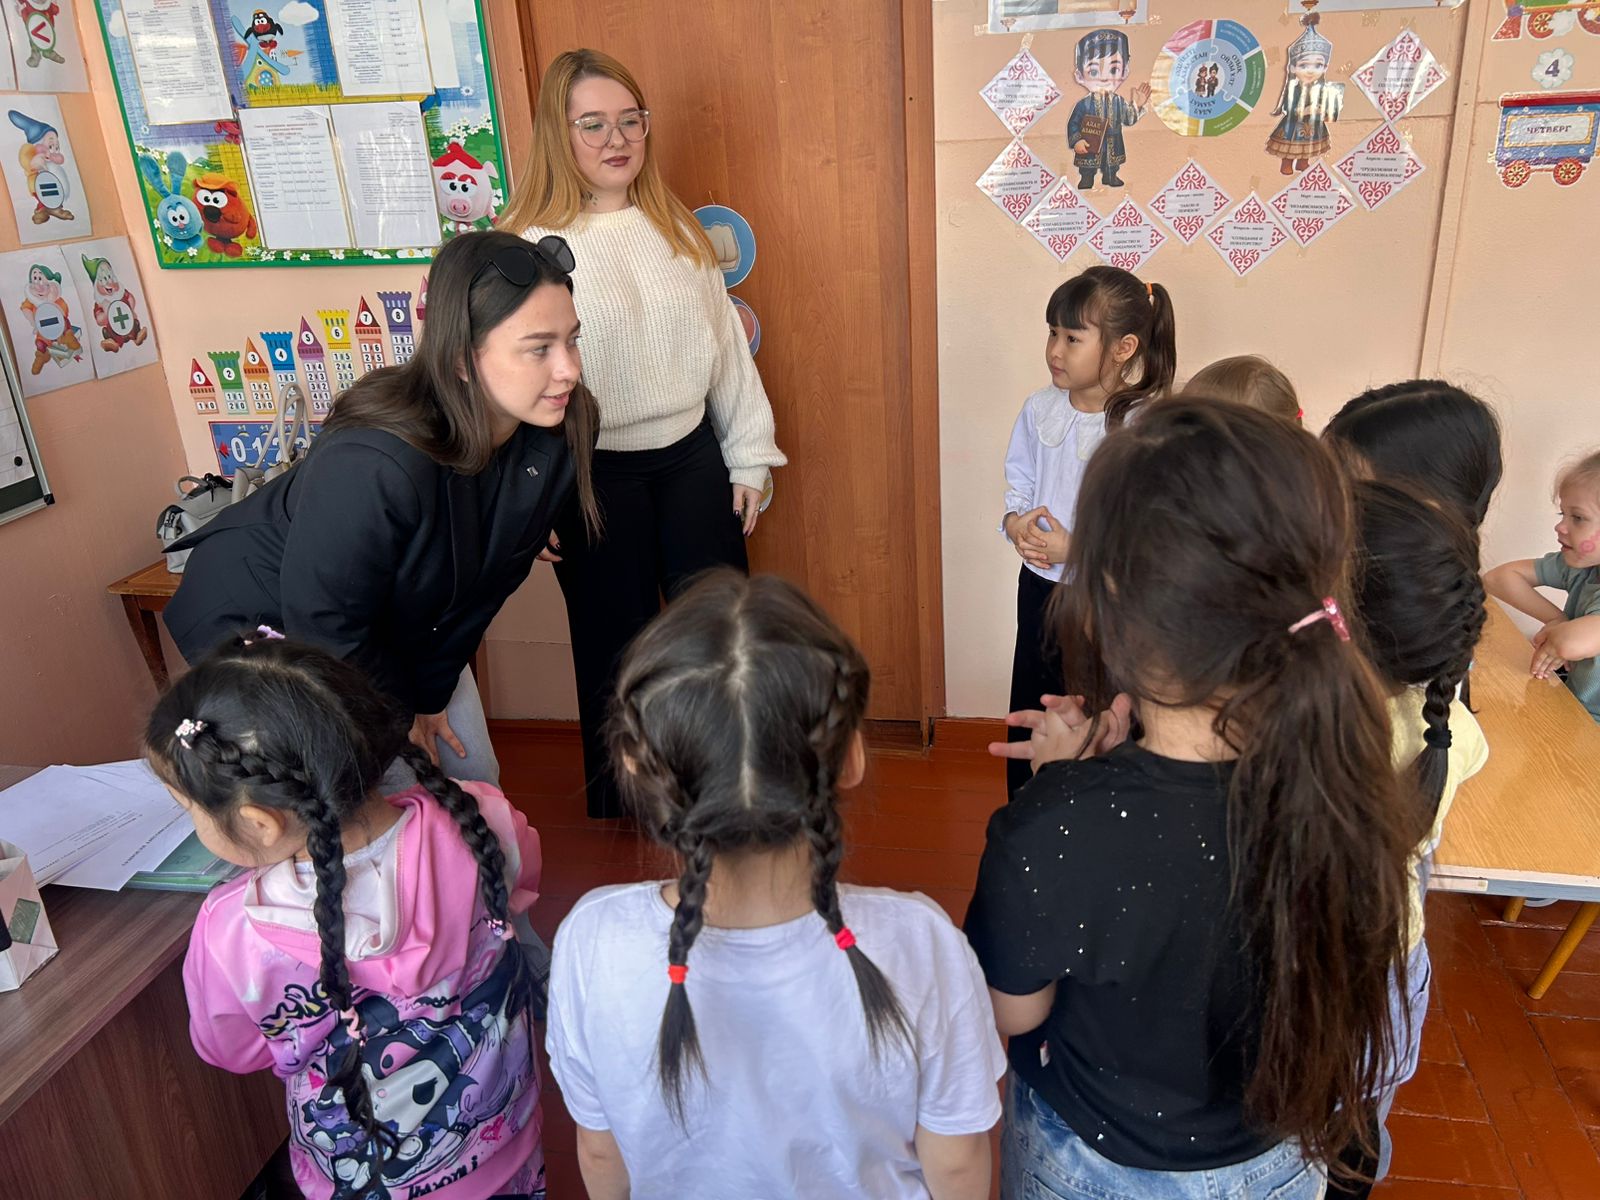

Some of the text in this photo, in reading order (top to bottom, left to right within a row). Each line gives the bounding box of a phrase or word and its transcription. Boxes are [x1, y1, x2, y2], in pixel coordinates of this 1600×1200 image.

[1544, 58, 1560, 78] 4
[1526, 125, 1572, 134] ЧЕТВЕРГ
[363, 313, 368, 322] 7
[395, 311, 402, 320] 8
[334, 328, 340, 338] 6
[305, 334, 311, 342] 5
[252, 354, 257, 362] 3
[278, 350, 284, 359] 4
[196, 374, 202, 382] 1
[226, 370, 232, 379] 2
[231, 437, 247, 463] 0
